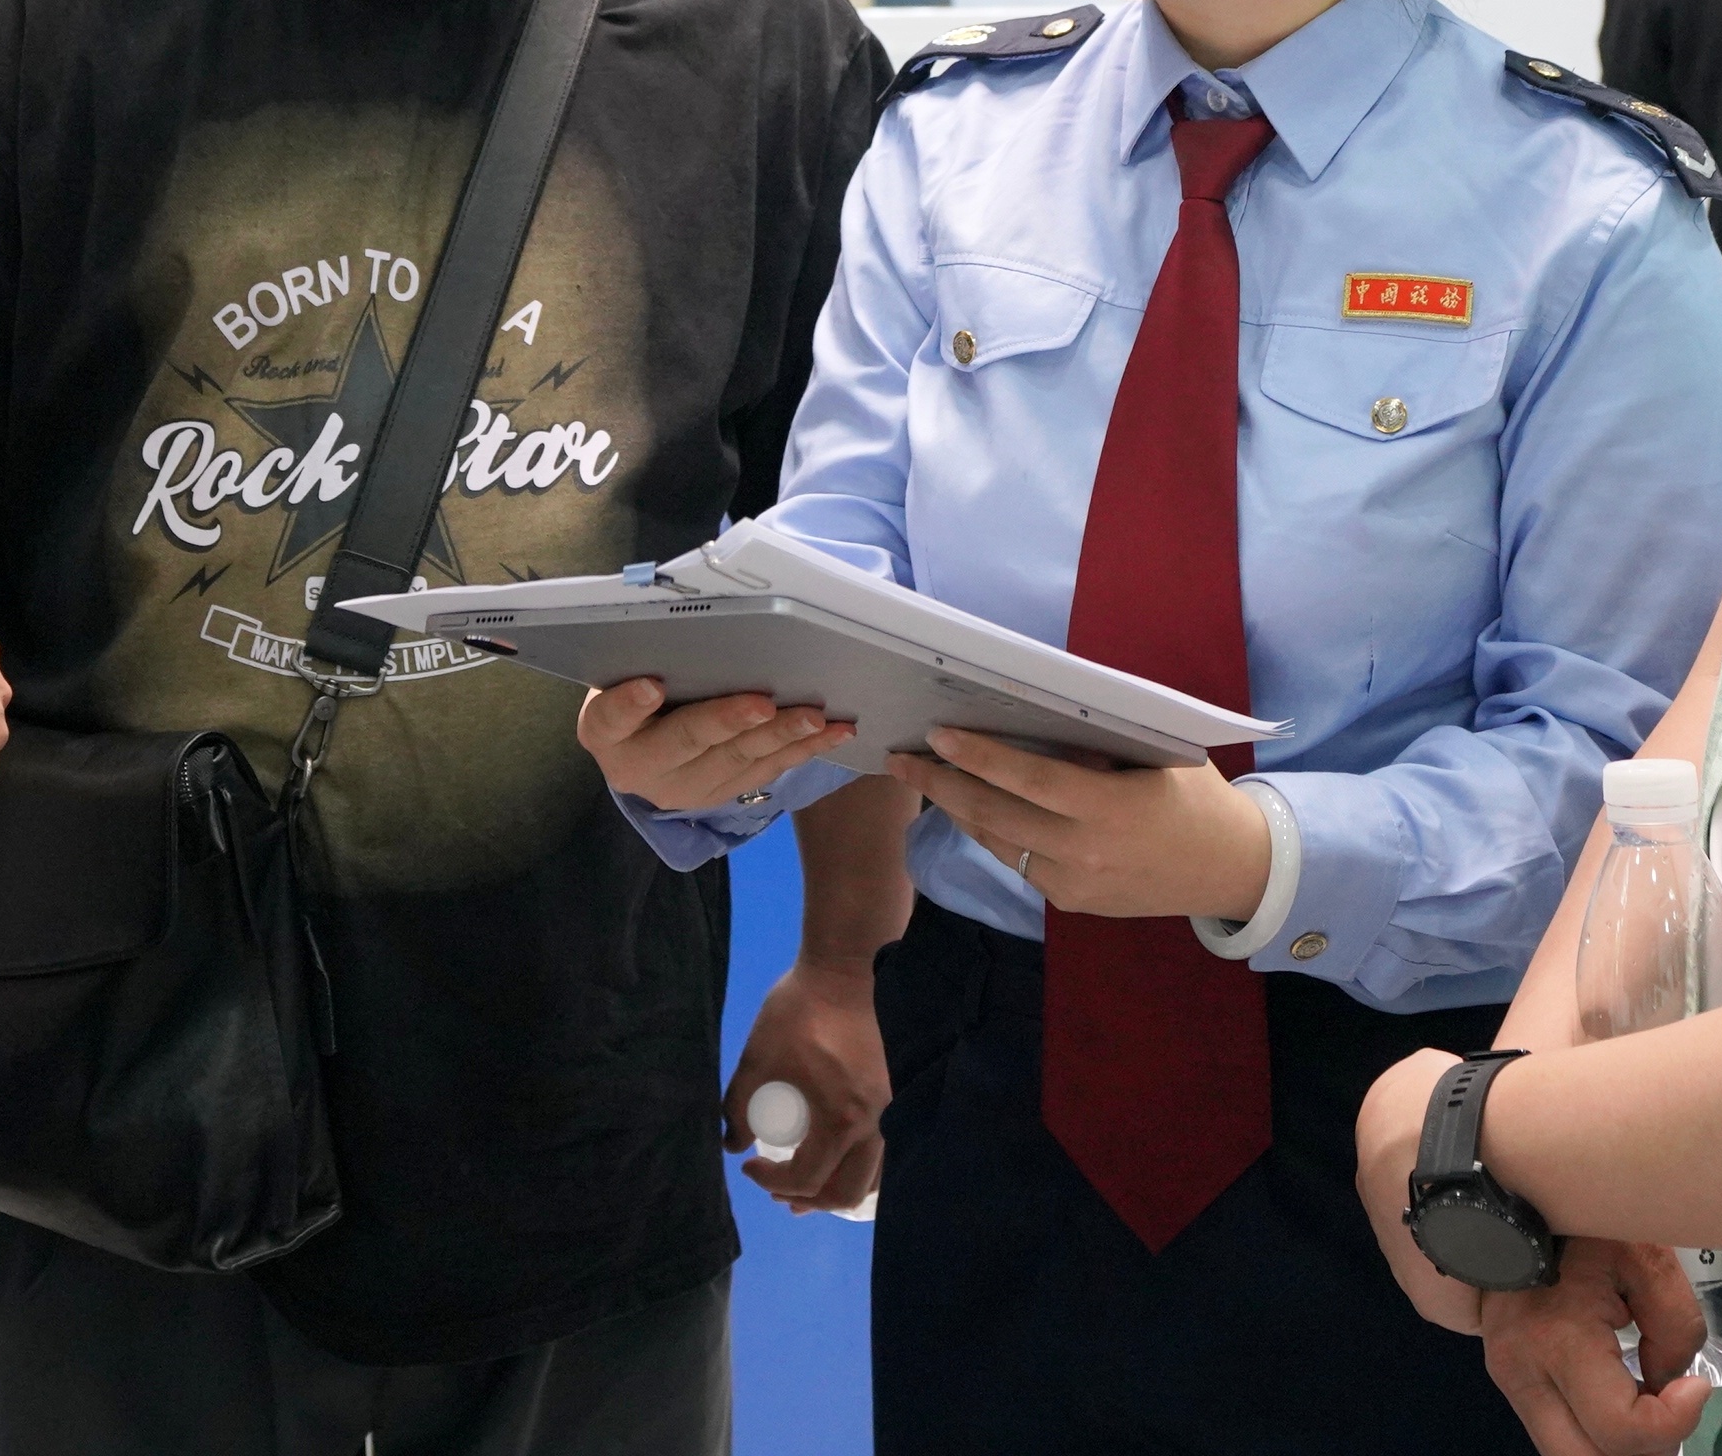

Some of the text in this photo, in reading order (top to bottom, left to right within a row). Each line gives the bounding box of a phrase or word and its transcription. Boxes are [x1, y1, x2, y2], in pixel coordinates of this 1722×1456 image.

[212, 248, 543, 351] BORN TO A
[132, 411, 361, 547] Rock
